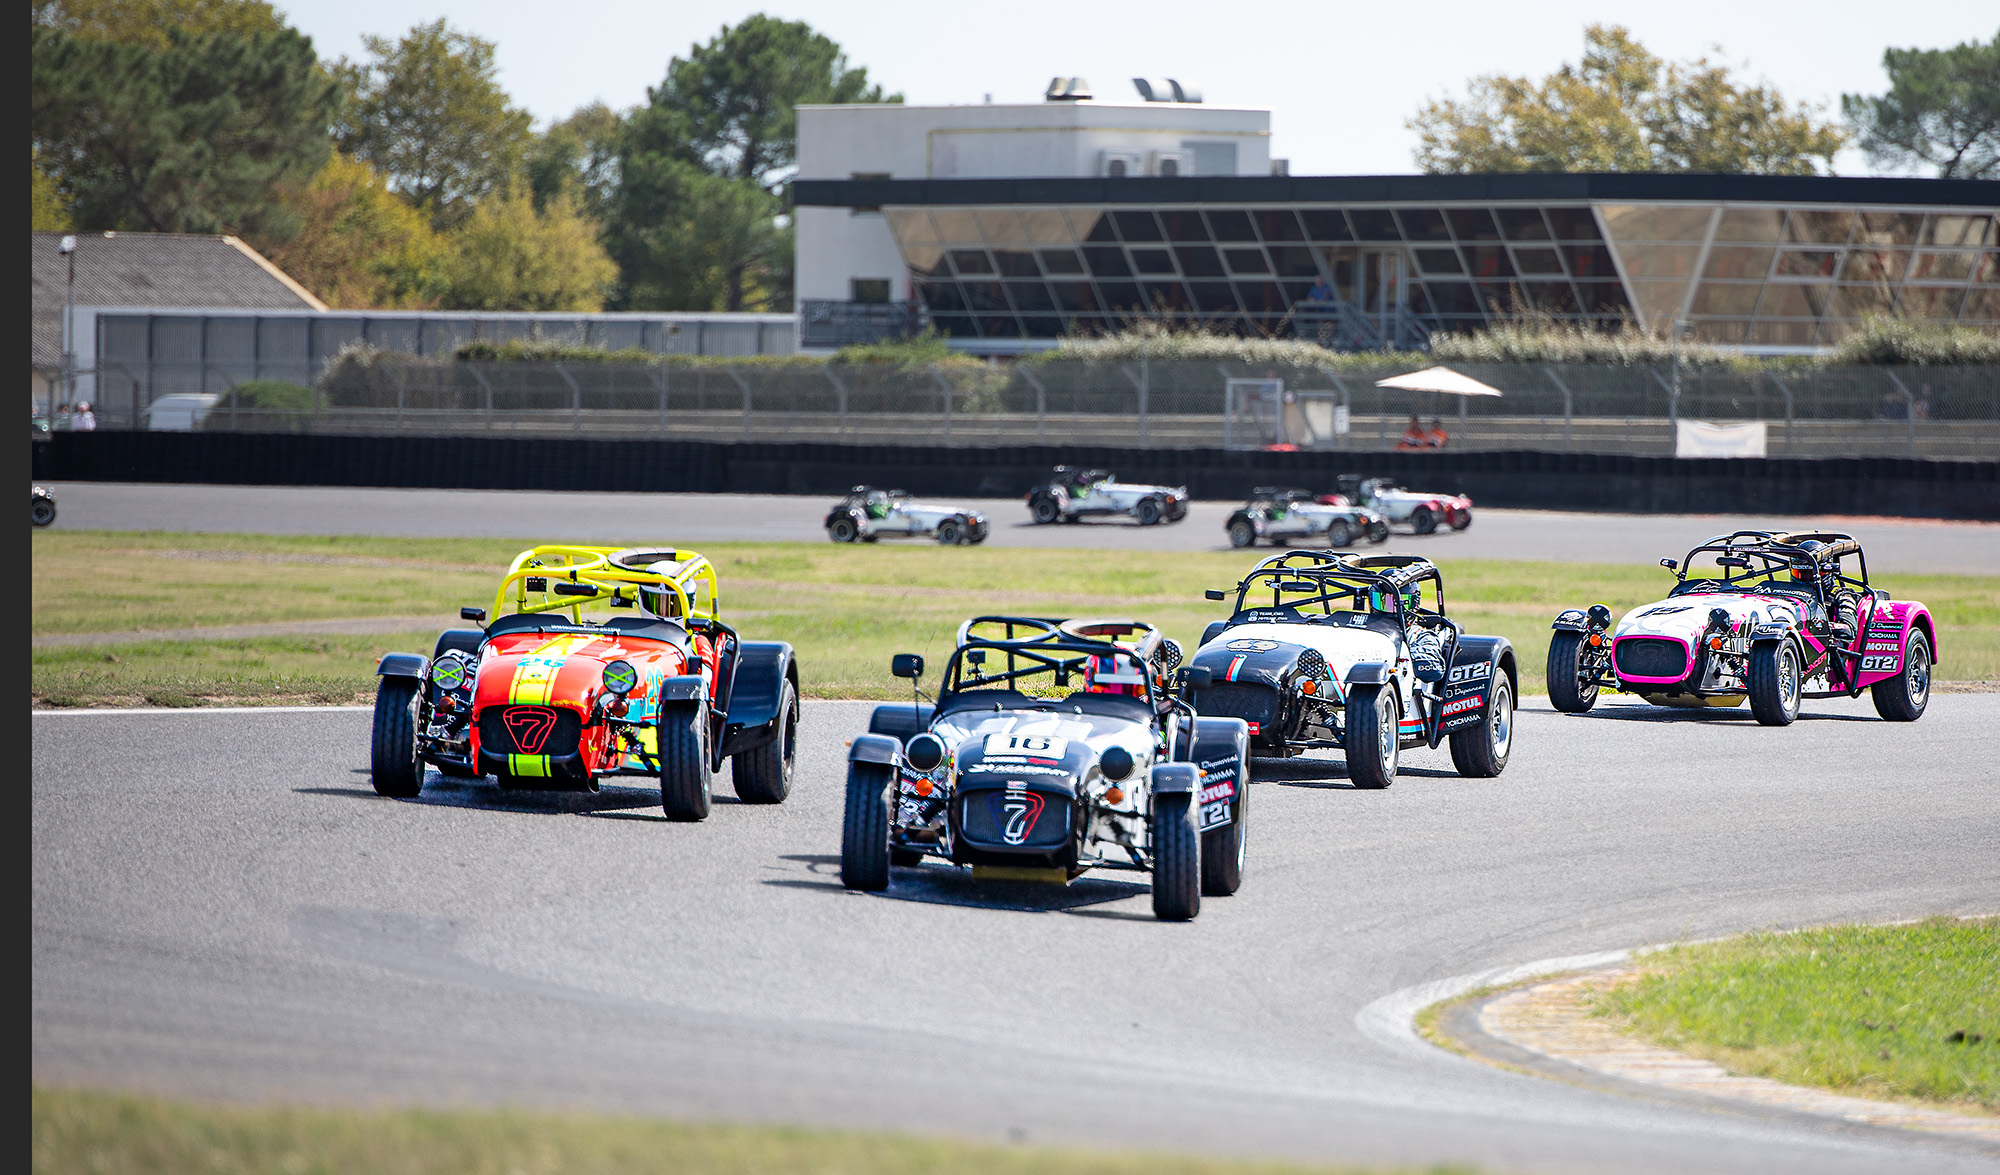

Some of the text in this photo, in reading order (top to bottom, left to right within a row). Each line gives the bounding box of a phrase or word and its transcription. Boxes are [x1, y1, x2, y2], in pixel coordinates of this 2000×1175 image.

[1865, 642, 1899, 652] MOTUL
[1449, 661, 1491, 682] GT2i
[1861, 655, 1899, 670] GT2i
[1442, 697, 1481, 715] MOTUL
[1445, 713, 1481, 728] YOKOHAMA
[509, 711, 551, 754] 7
[1199, 783, 1233, 802] OTUL
